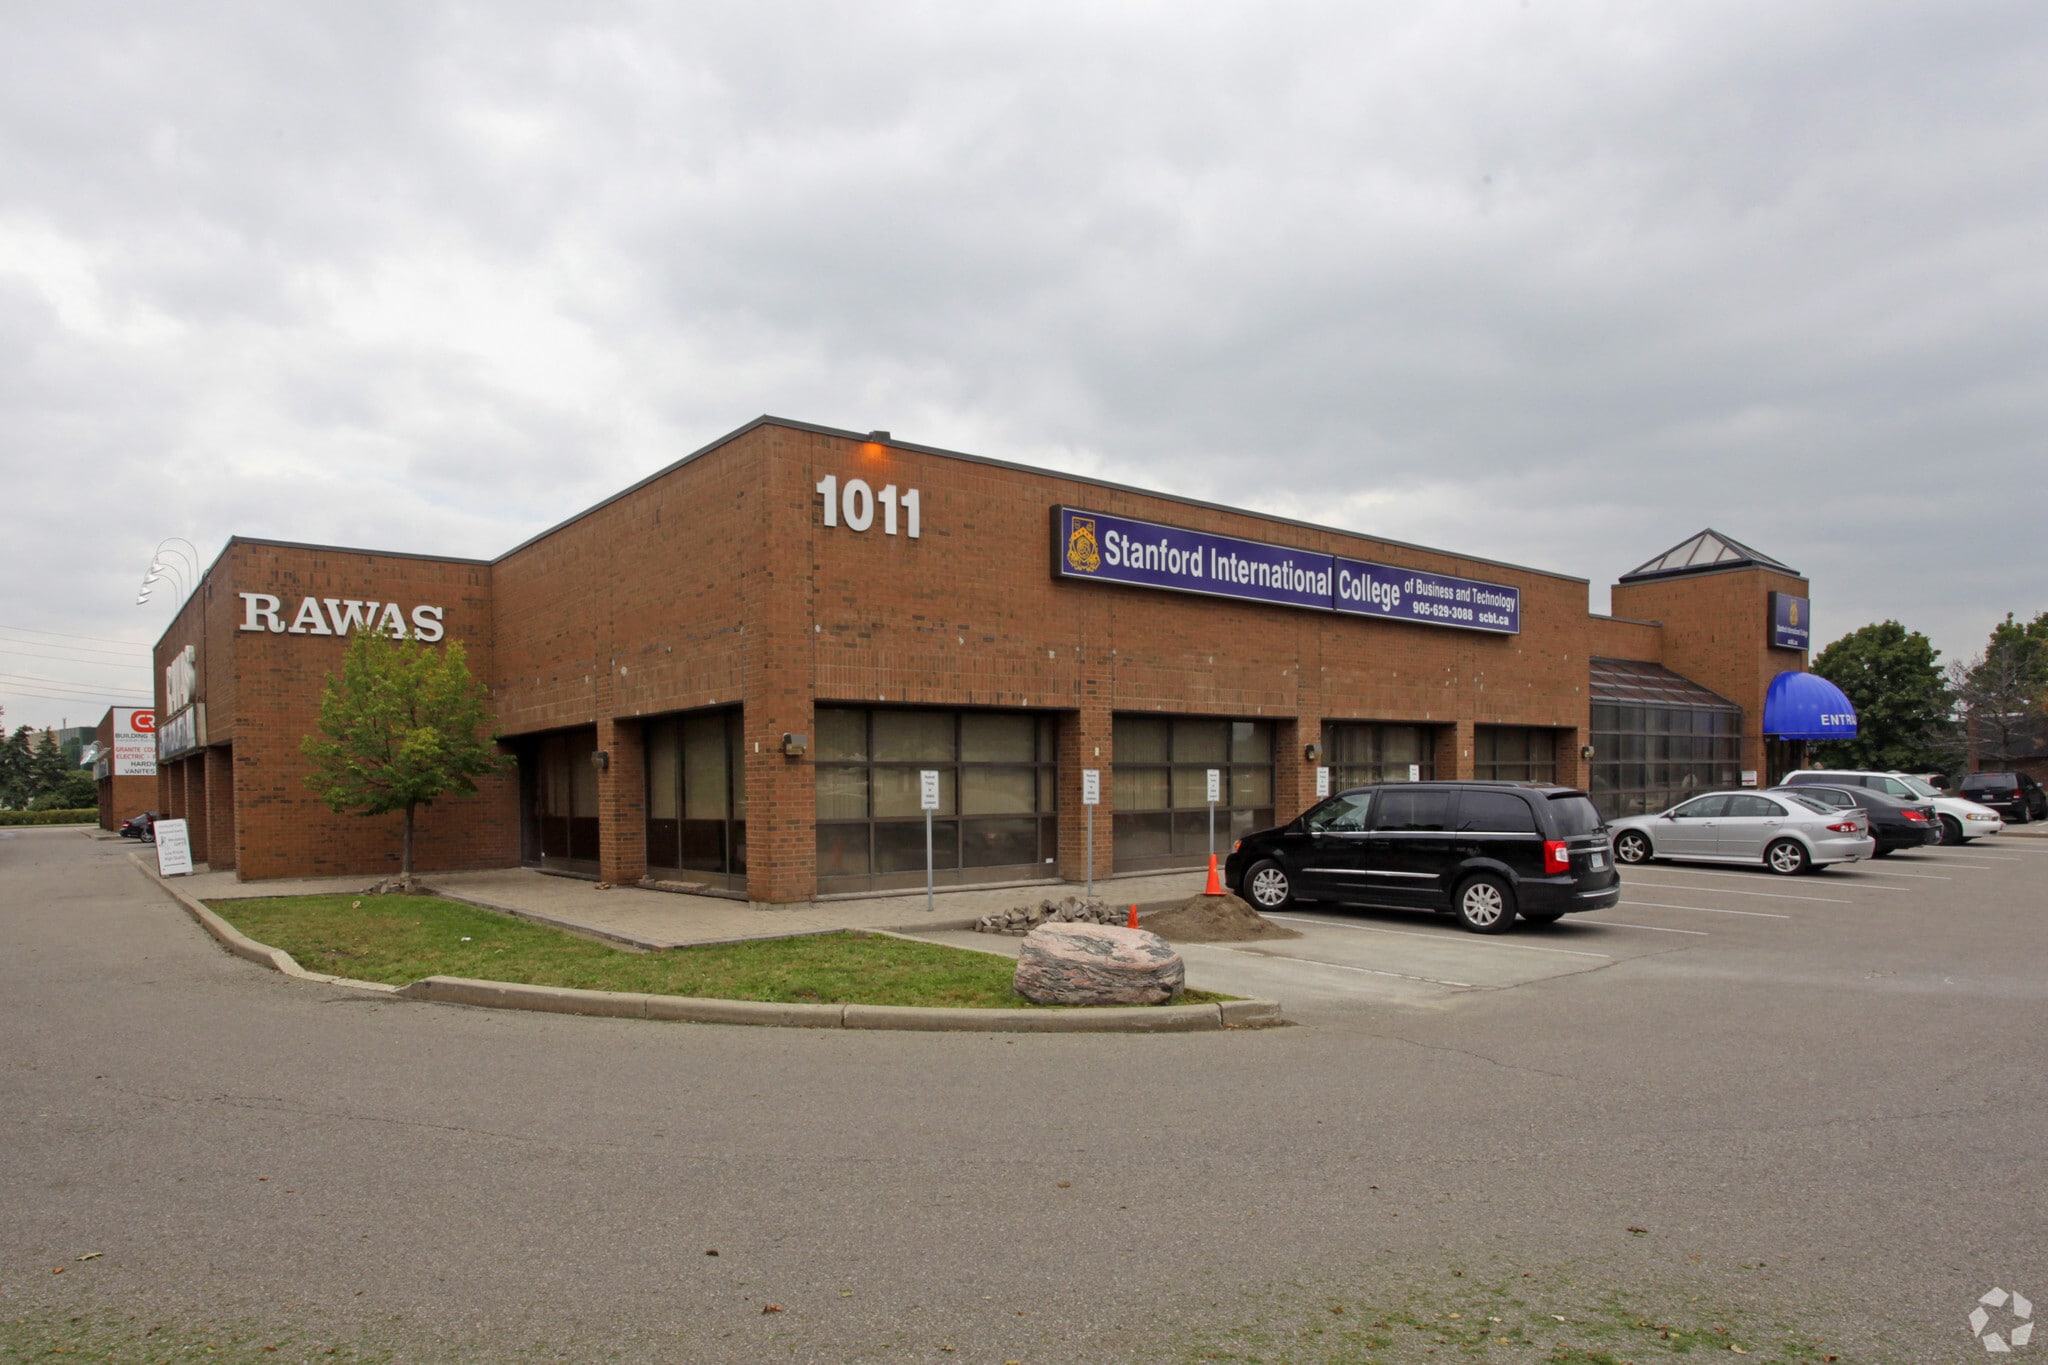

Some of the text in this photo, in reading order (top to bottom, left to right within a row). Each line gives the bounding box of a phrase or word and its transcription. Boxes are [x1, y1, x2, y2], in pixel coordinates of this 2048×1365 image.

[815, 473, 920, 539] 1011
[1104, 529, 1401, 612] Stanford International College
[1404, 577, 1516, 613] of Business and Technology
[238, 591, 445, 643] RAWAS
[1478, 611, 1509, 626] scbt.ca
